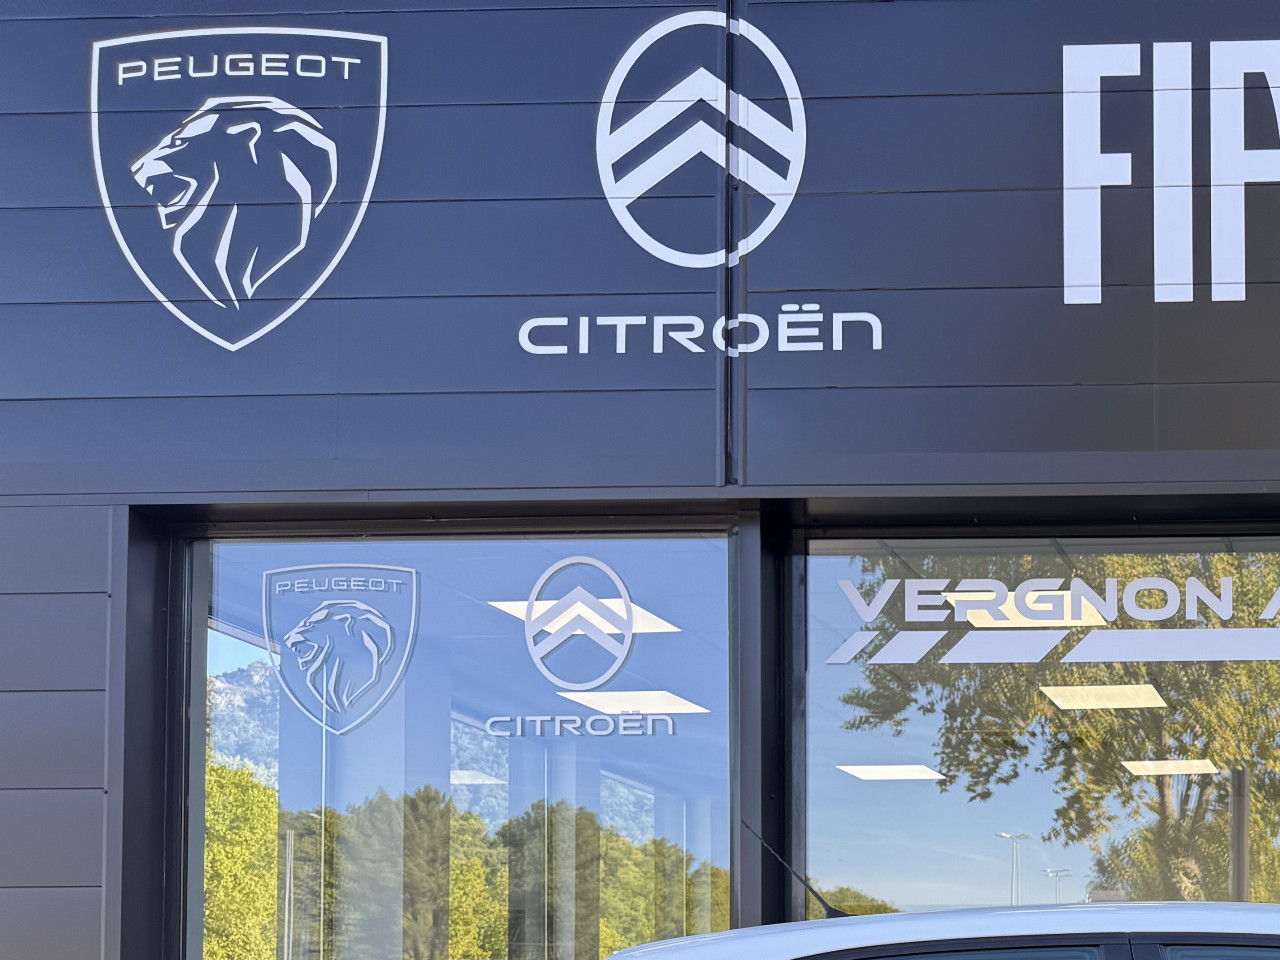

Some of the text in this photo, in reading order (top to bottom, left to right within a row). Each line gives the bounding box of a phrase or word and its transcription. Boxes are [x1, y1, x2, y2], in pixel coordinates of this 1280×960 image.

[117, 54, 361, 86] PEUGEOT
[518, 303, 882, 358] CITROËN
[275, 577, 405, 594] PEUGEOT
[837, 576, 1234, 622] VERGNON
[485, 710, 674, 737] CITROËN
